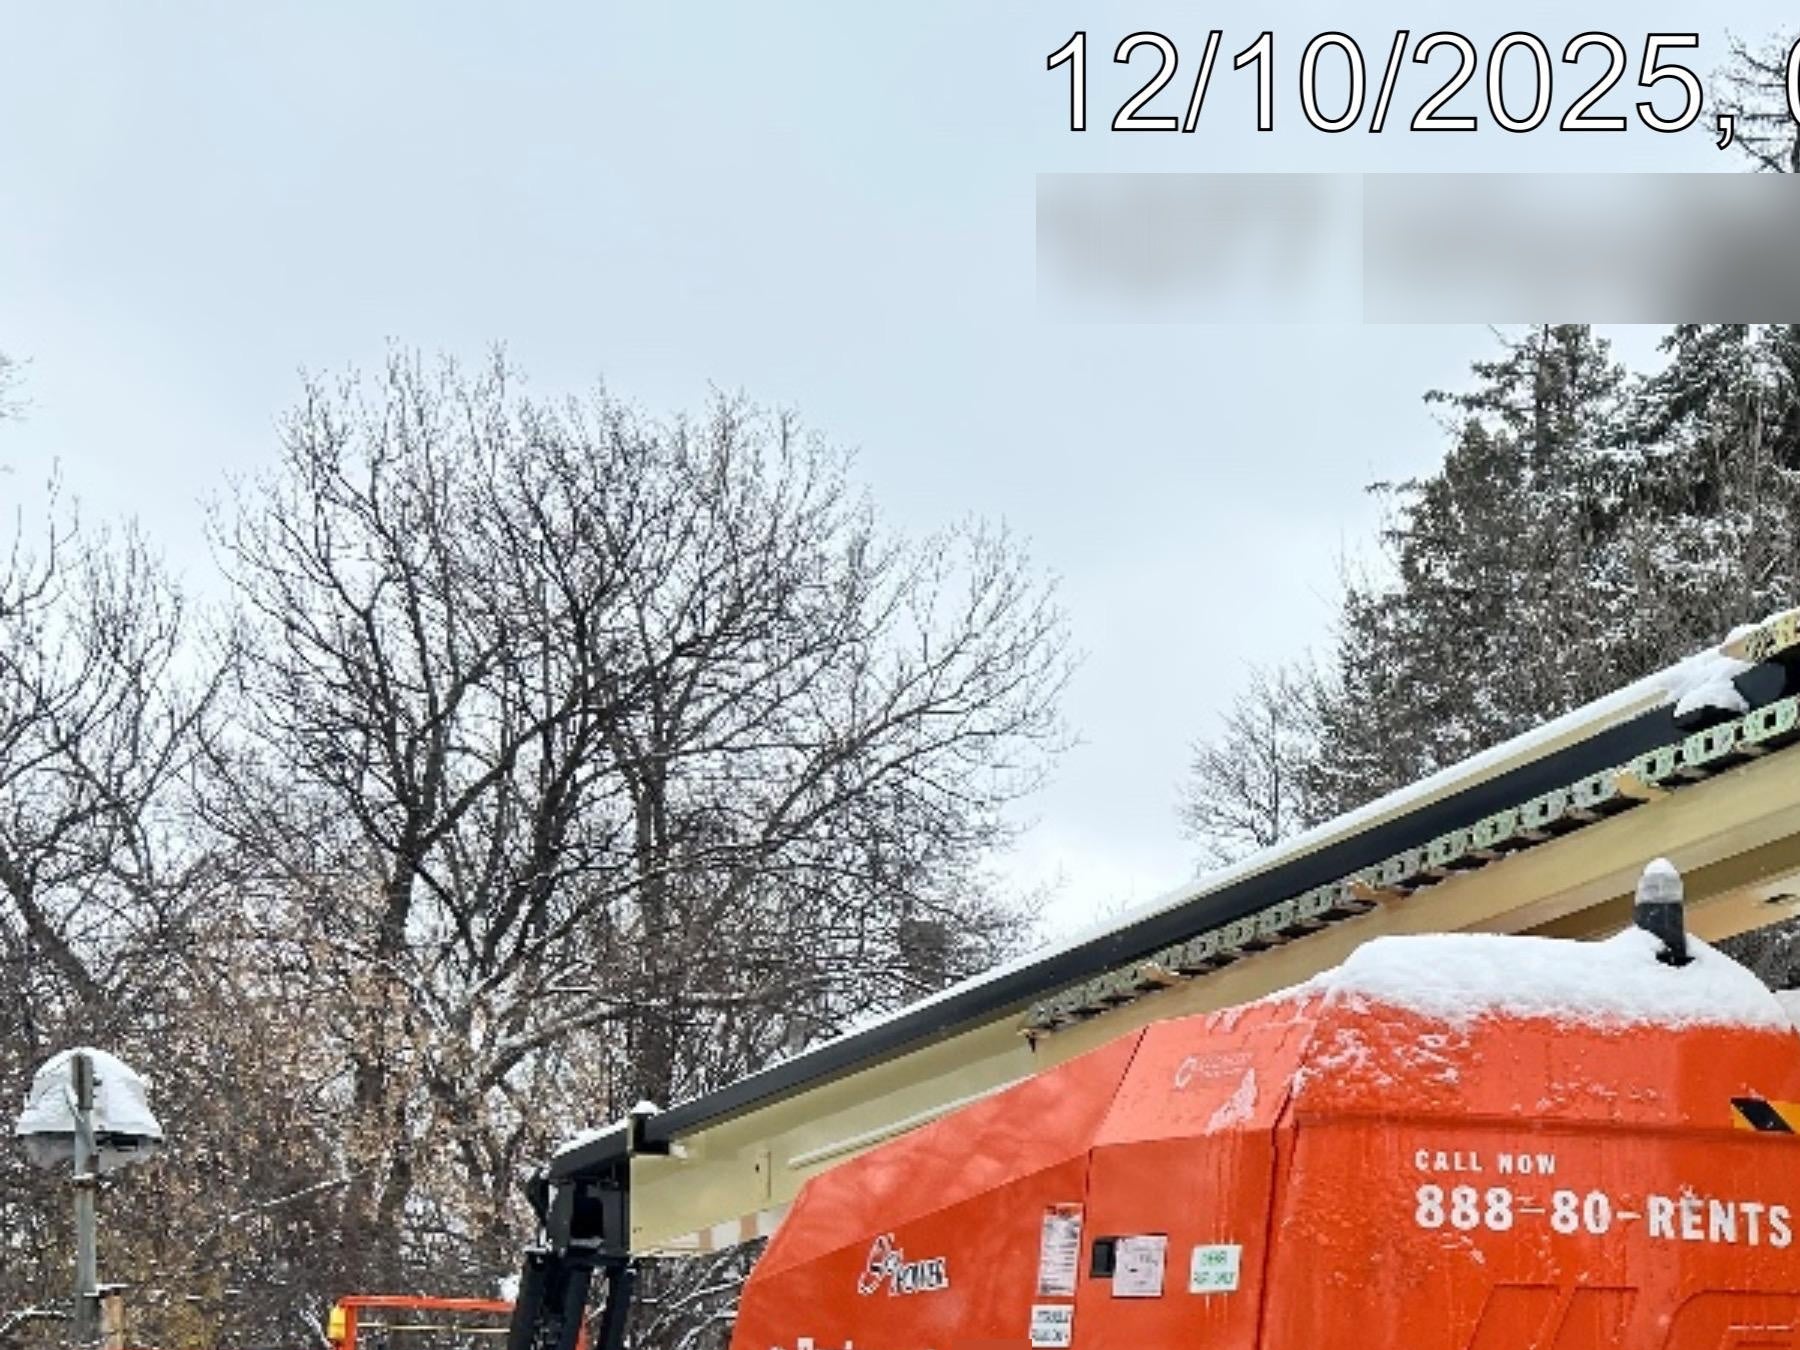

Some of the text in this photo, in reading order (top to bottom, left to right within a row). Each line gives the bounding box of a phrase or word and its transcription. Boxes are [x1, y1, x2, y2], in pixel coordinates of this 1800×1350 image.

[1415, 1150, 1556, 1175] CALL NOW
[1415, 1184, 1793, 1248] 888-80-RENTS
